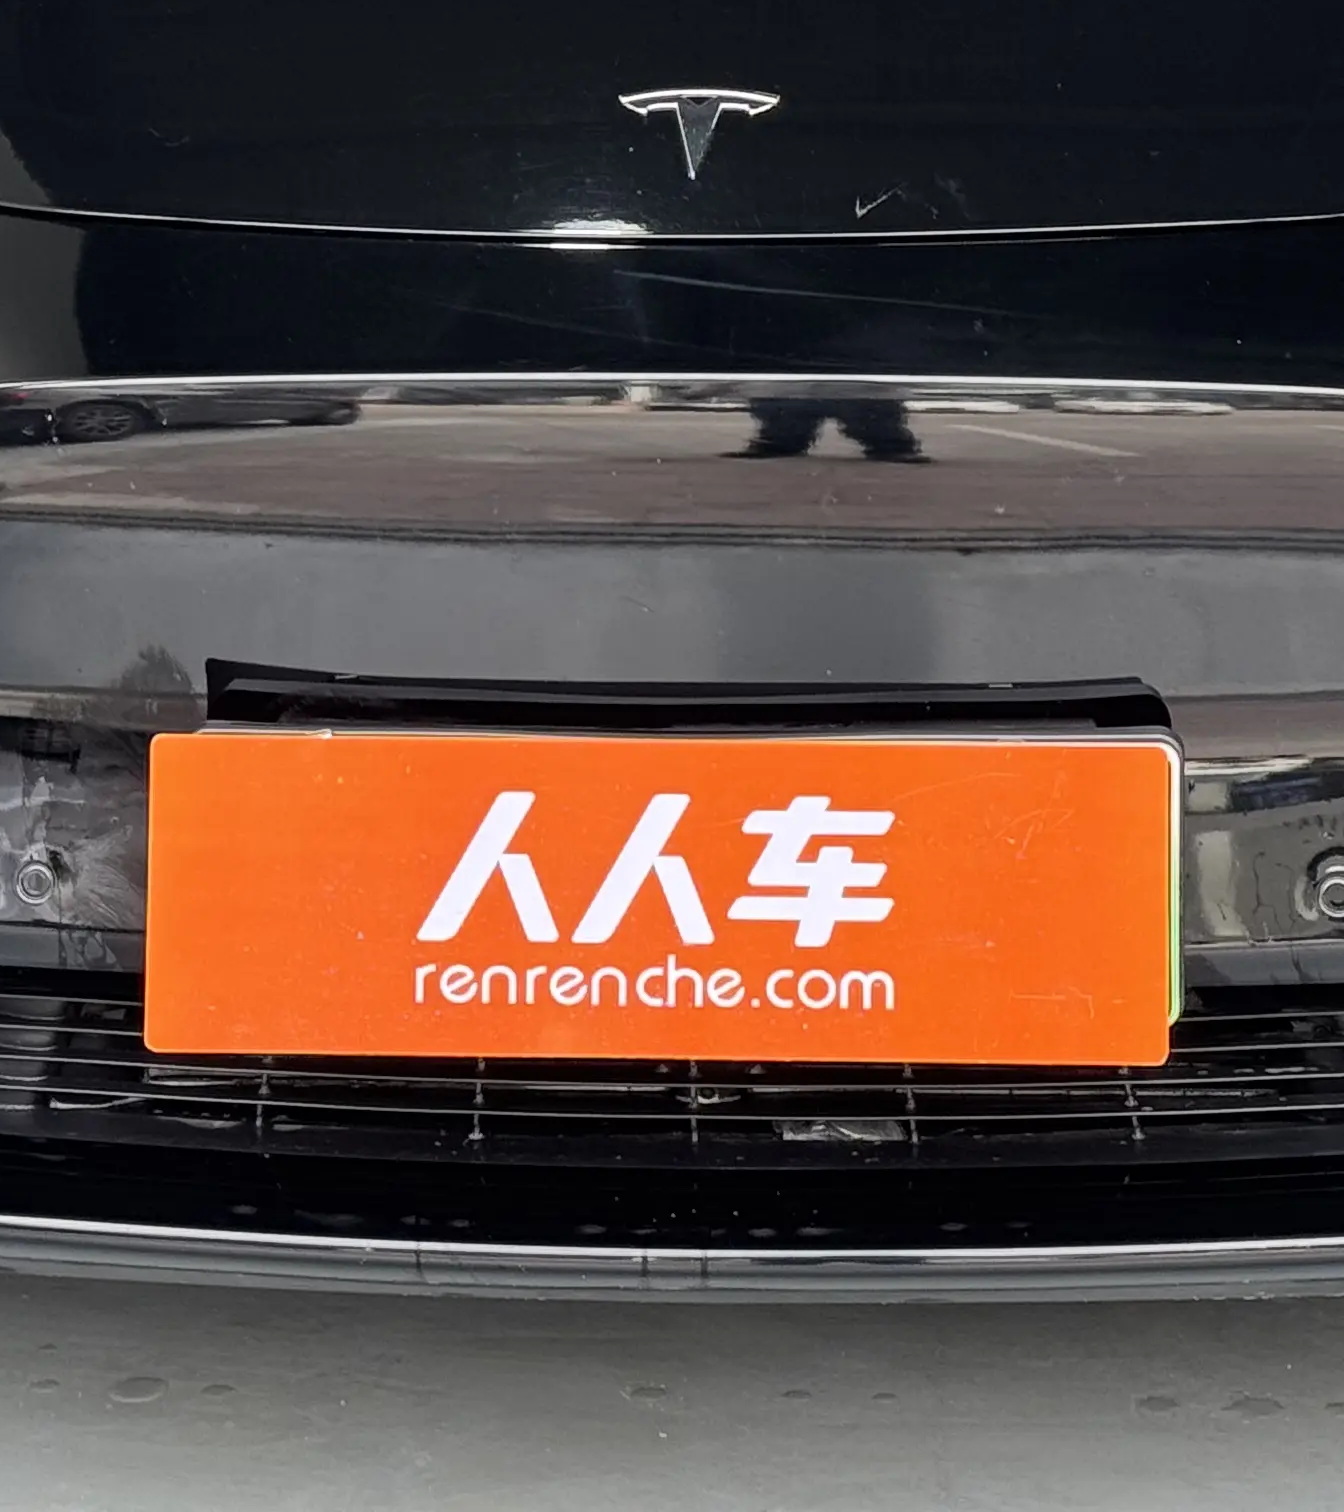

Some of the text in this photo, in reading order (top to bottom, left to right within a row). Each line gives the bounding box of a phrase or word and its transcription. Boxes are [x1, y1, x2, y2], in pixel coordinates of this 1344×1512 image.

[416, 791, 895, 947] 人人车
[414, 955, 894, 1009] renrenche.com
